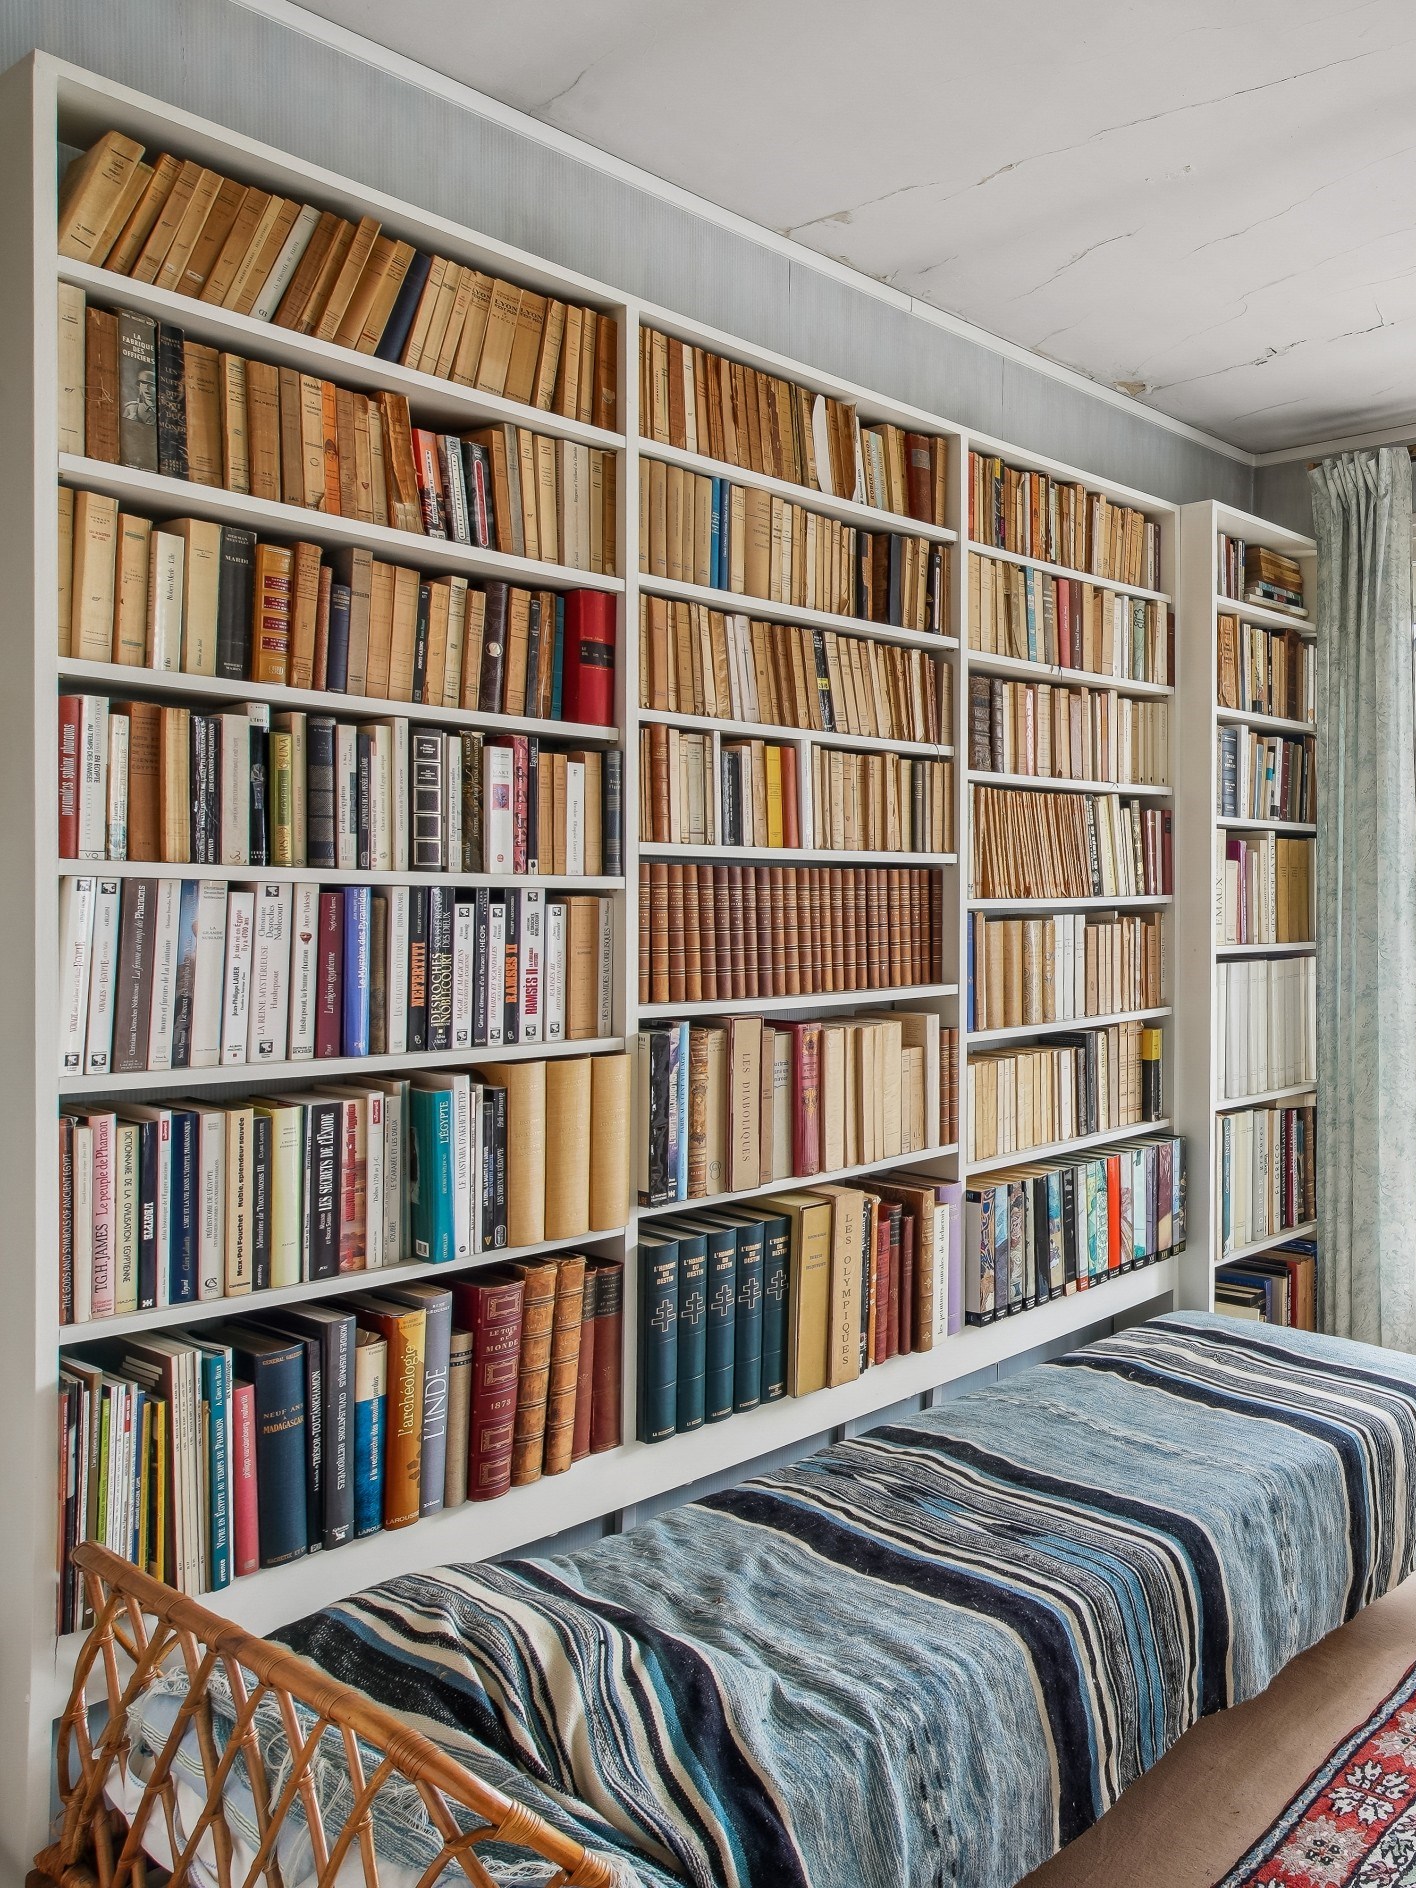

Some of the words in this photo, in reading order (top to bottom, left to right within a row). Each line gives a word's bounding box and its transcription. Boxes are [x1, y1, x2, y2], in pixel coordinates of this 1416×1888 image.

[134, 332, 142, 340] LA
[225, 554, 248, 566] MARDI
[59, 724, 75, 754] pharaons
[60, 757, 75, 778] sphinx
[59, 782, 74, 815] pyramides
[280, 840, 288, 859] ARS
[135, 885, 146, 919] Pharaons
[358, 889, 368, 929] Pyramides
[258, 906, 266, 937] Christiane
[266, 905, 275, 938] Desroches
[274, 903, 284, 940] Noblecourt
[358, 931, 366, 945] des
[506, 944, 517, 953] II
[257, 945, 268, 998] MYSTÉRIEUSE
[358, 947, 367, 979] Mystère
[411, 942, 425, 1007] NEFERTITI
[132, 971, 141, 979] La
[358, 980, 365, 988] Le
[132, 983, 140, 1008] Noblecourt
[430, 952, 442, 1023] DESROCHES
[441, 952, 452, 1022] NOBLECOURT
[523, 977, 538, 1014] RAMSÈS
[258, 1000, 267, 1023] REINE
[257, 1026, 265, 1035] LA
[742, 1053, 751, 1073] LES
[439, 1101, 449, 1144] L'ÉGYPTE
[740, 1081, 751, 1161] DIABOLIQUES
[96, 1121, 108, 1159] Pharaon
[319, 1146, 334, 1157] DE
[62, 1153, 71, 1175] EGYPT
[97, 1159, 108, 1170] de
[124, 1131, 133, 1175] DICTIONNAIRE
[238, 1145, 246, 1183] splendeur
[97, 1171, 110, 1201] peuple
[124, 1178, 132, 1186] DE
[318, 1160, 333, 1193] SECRETS
[62, 1176, 71, 1208] ANCIENT
[124, 1190, 132, 1199] LA
[319, 1196, 332, 1211] LES
[62, 1209, 71, 1219] OF
[97, 1203, 108, 1216] Le
[62, 1220, 71, 1253] SYMBOLS
[95, 1223, 110, 1259] JAMES
[845, 1214, 853, 1245] LES
[938, 1245, 944, 1253] de
[62, 1254, 71, 1271] AND
[654, 1261, 676, 1272] L'HOMME
[717, 1262, 733, 1271] DESTIN
[62, 1272, 71, 1294] GODS
[657, 1276, 674, 1285] DESTIN
[62, 1294, 71, 1309] THE
[841, 1256, 852, 1365] OLYMPIQUES
[339, 1324, 348, 1353] MONDES
[486, 1339, 519, 1352] MONDE
[338, 1354, 347, 1387] DISPARUS
[372, 1375, 380, 1398] perdus
[398, 1345, 419, 1438] l'archéologie
[264, 1409, 287, 1419] NEUF
[423, 1365, 447, 1441] L'INDE
[490, 1398, 511, 1410] 1873
[338, 1392, 346, 1441] CIVILISATIONS
[214, 1418, 224, 1449] PHARAON
[371, 1423, 379, 1435] des
[217, 1451, 225, 1459] DE
[370, 1436, 379, 1467] recherche
[217, 1461, 225, 1480] TEMPS
[337, 1443, 346, 1490] RETROUVÉES
[218, 1482, 225, 1490] AU
[215, 1492, 226, 1516] ÉGYPTE
[217, 1517, 225, 1526] EN
[216, 1528, 226, 1548] VIVRE
